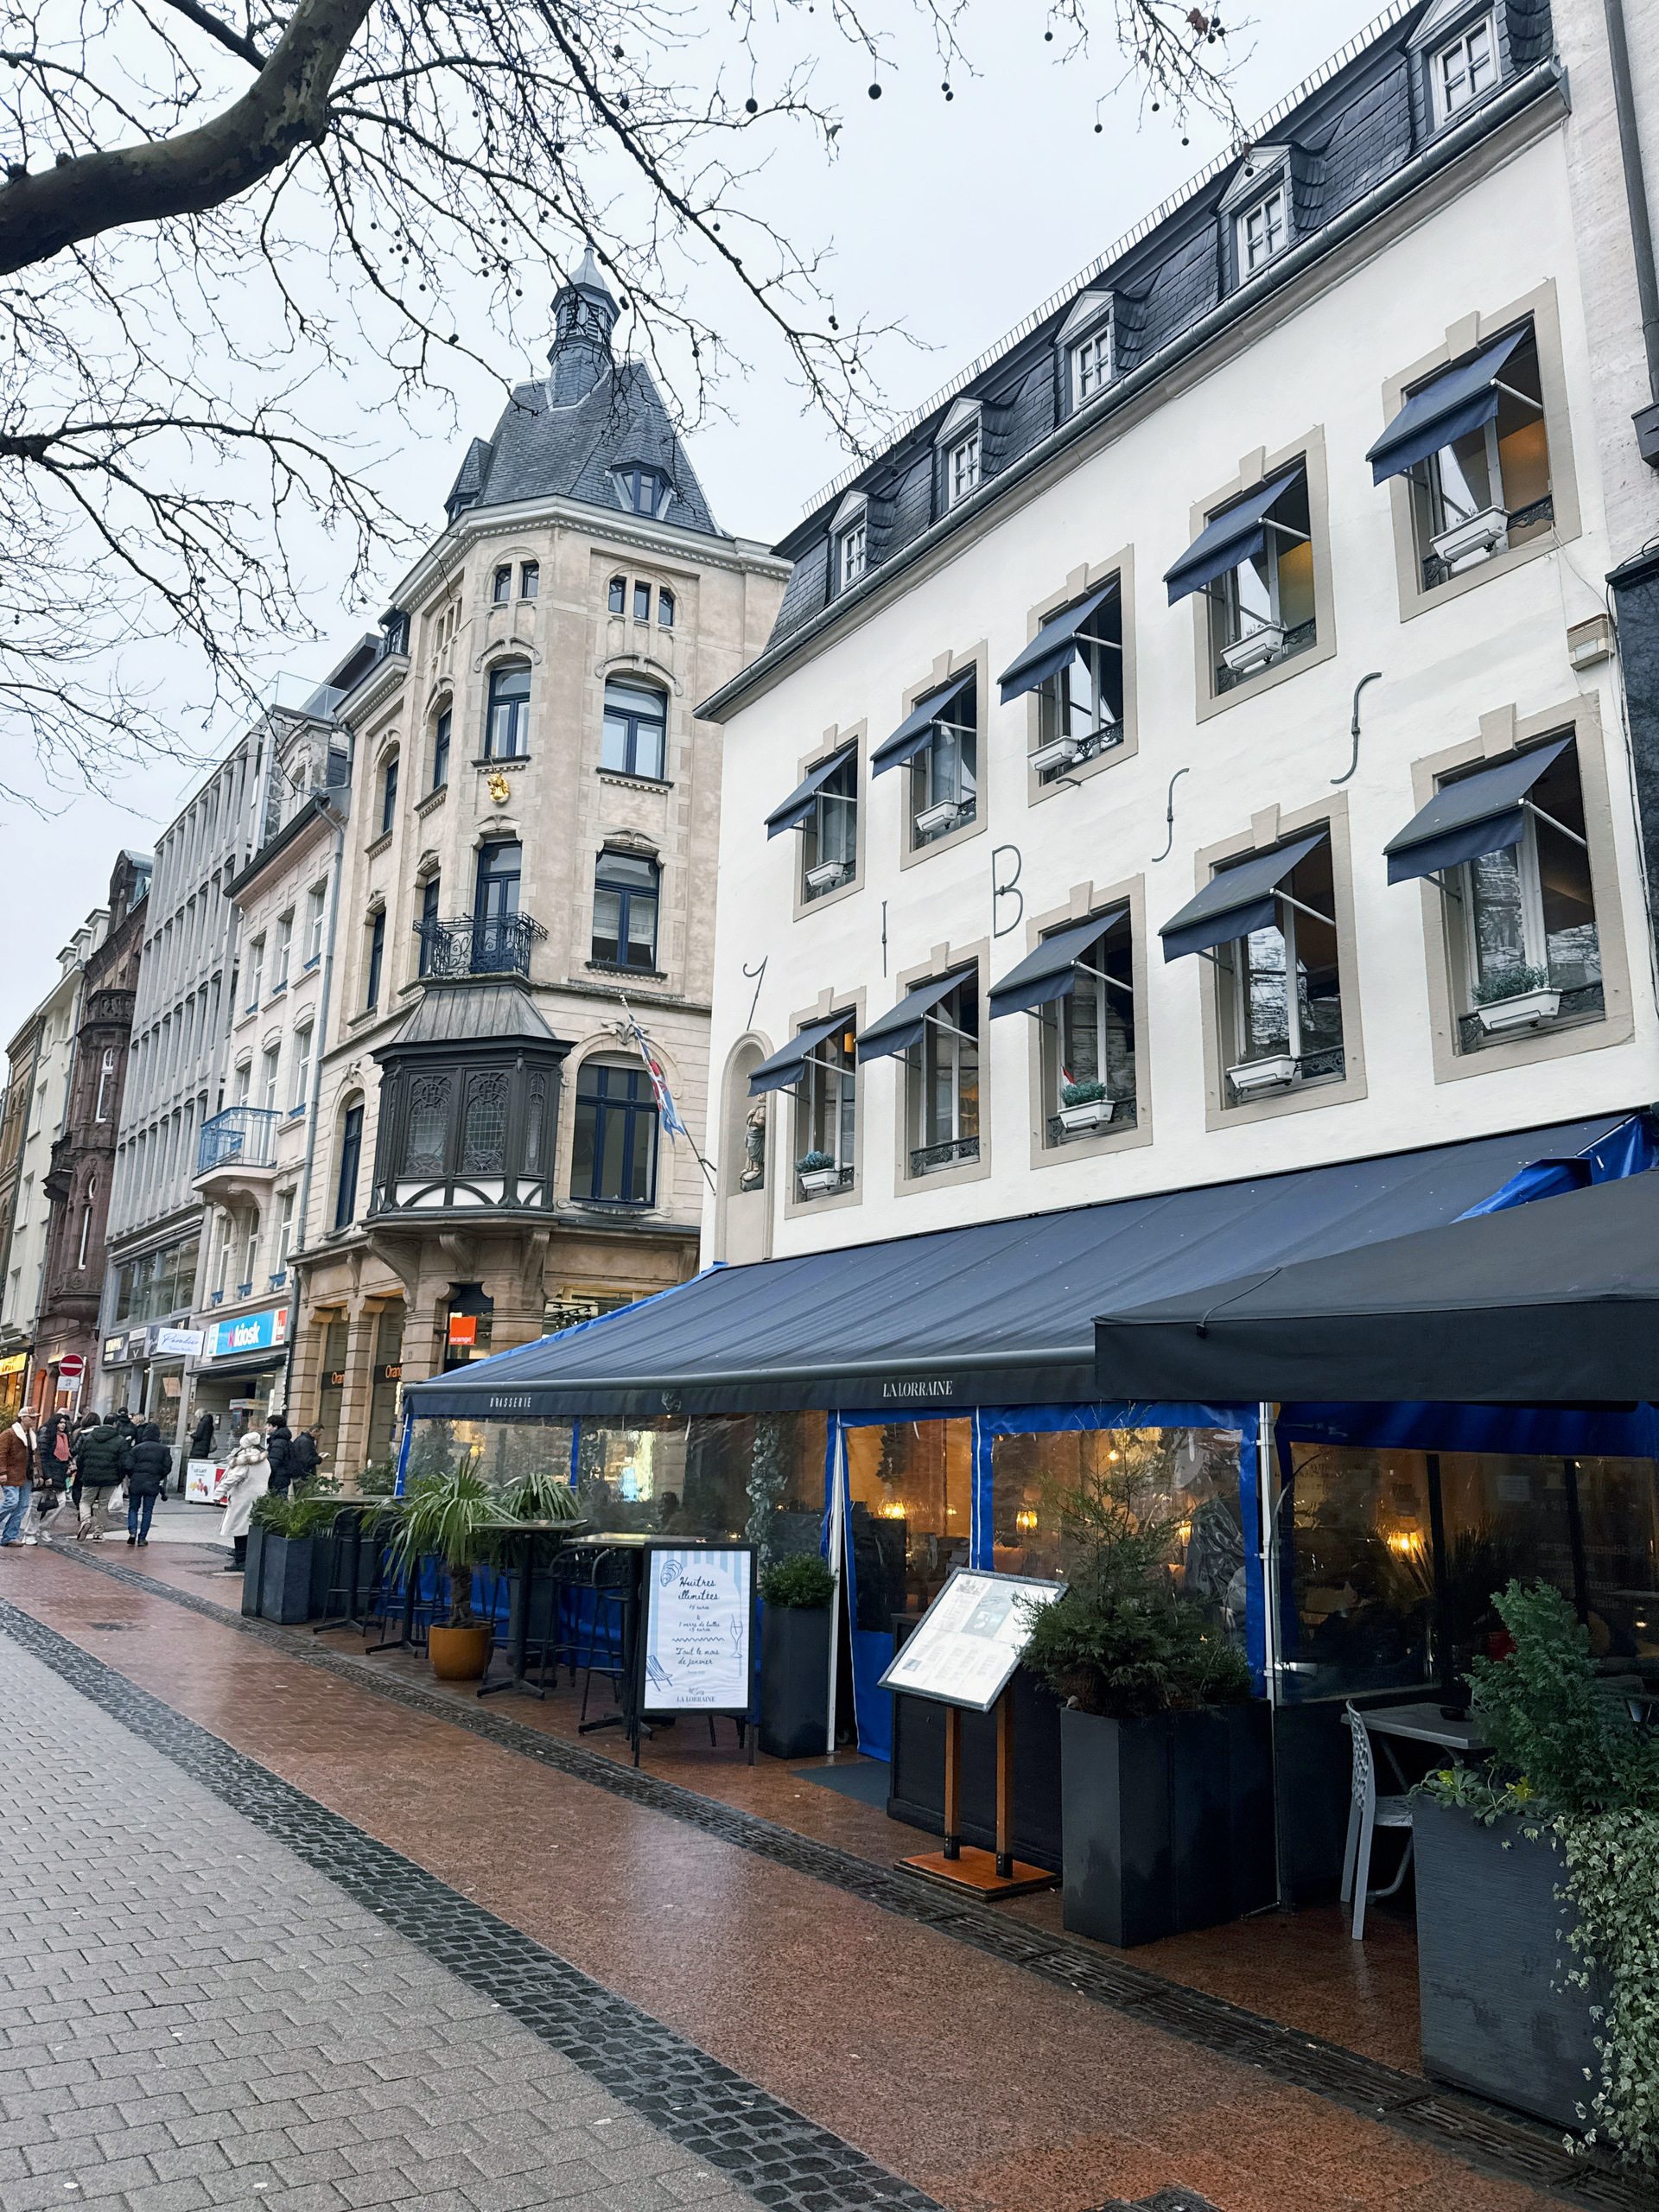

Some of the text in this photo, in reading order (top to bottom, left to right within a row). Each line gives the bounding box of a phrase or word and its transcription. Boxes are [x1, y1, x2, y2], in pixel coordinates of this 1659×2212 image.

[233, 1320, 260, 1347] kiosk
[385, 1364, 402, 1379] Oran
[882, 1380, 953, 1398] LA LORRAINE
[489, 1396, 532, 1408] BRASSERIE
[675, 1646, 694, 1656] Tout
[677, 1656, 713, 1668] de janvier
